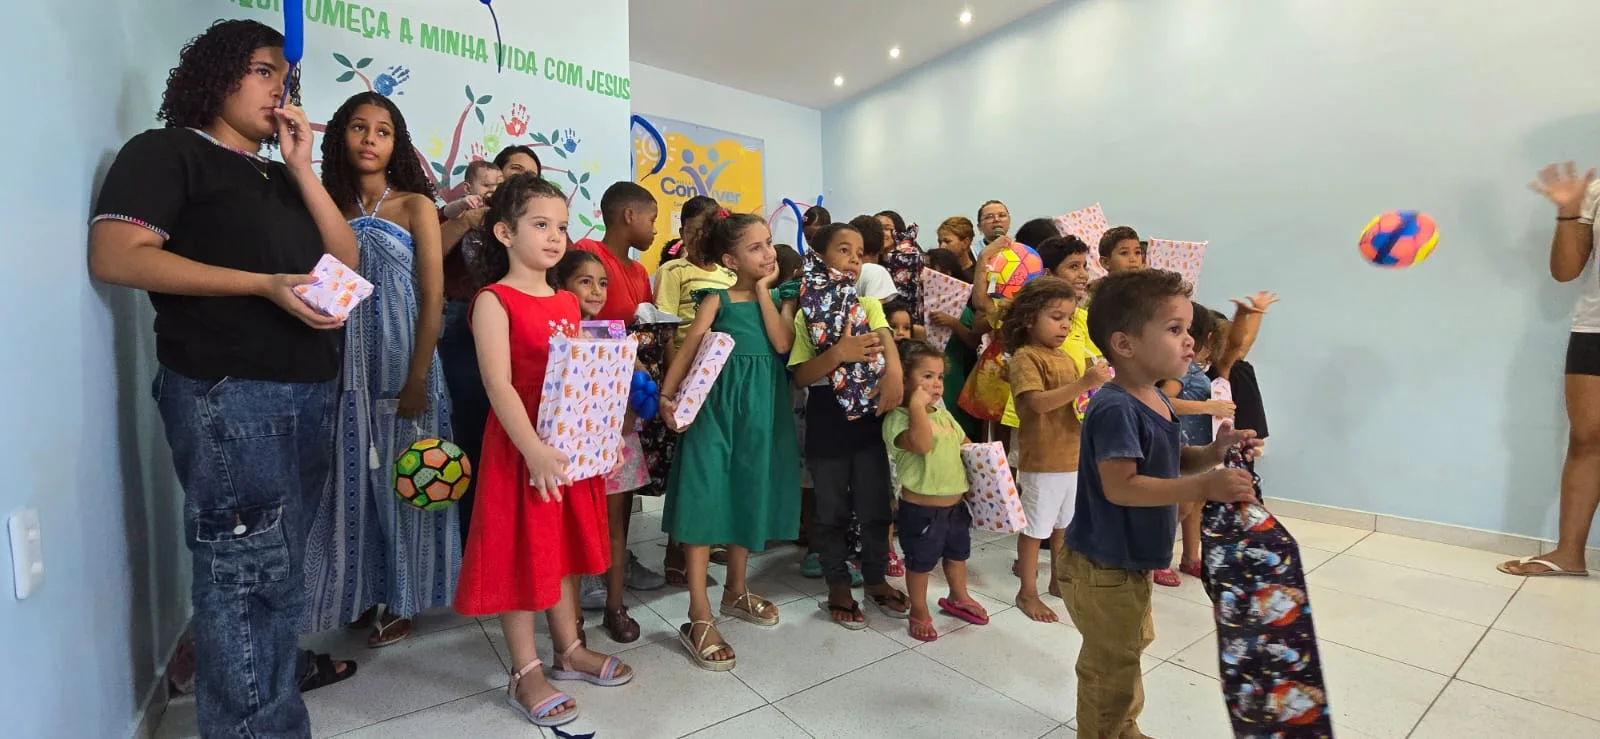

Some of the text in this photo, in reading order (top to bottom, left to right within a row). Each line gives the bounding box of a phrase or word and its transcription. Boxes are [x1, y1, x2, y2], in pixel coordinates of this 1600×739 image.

[305, 0, 631, 100] OMEÇA A MINHA VIDA COM JESUS
